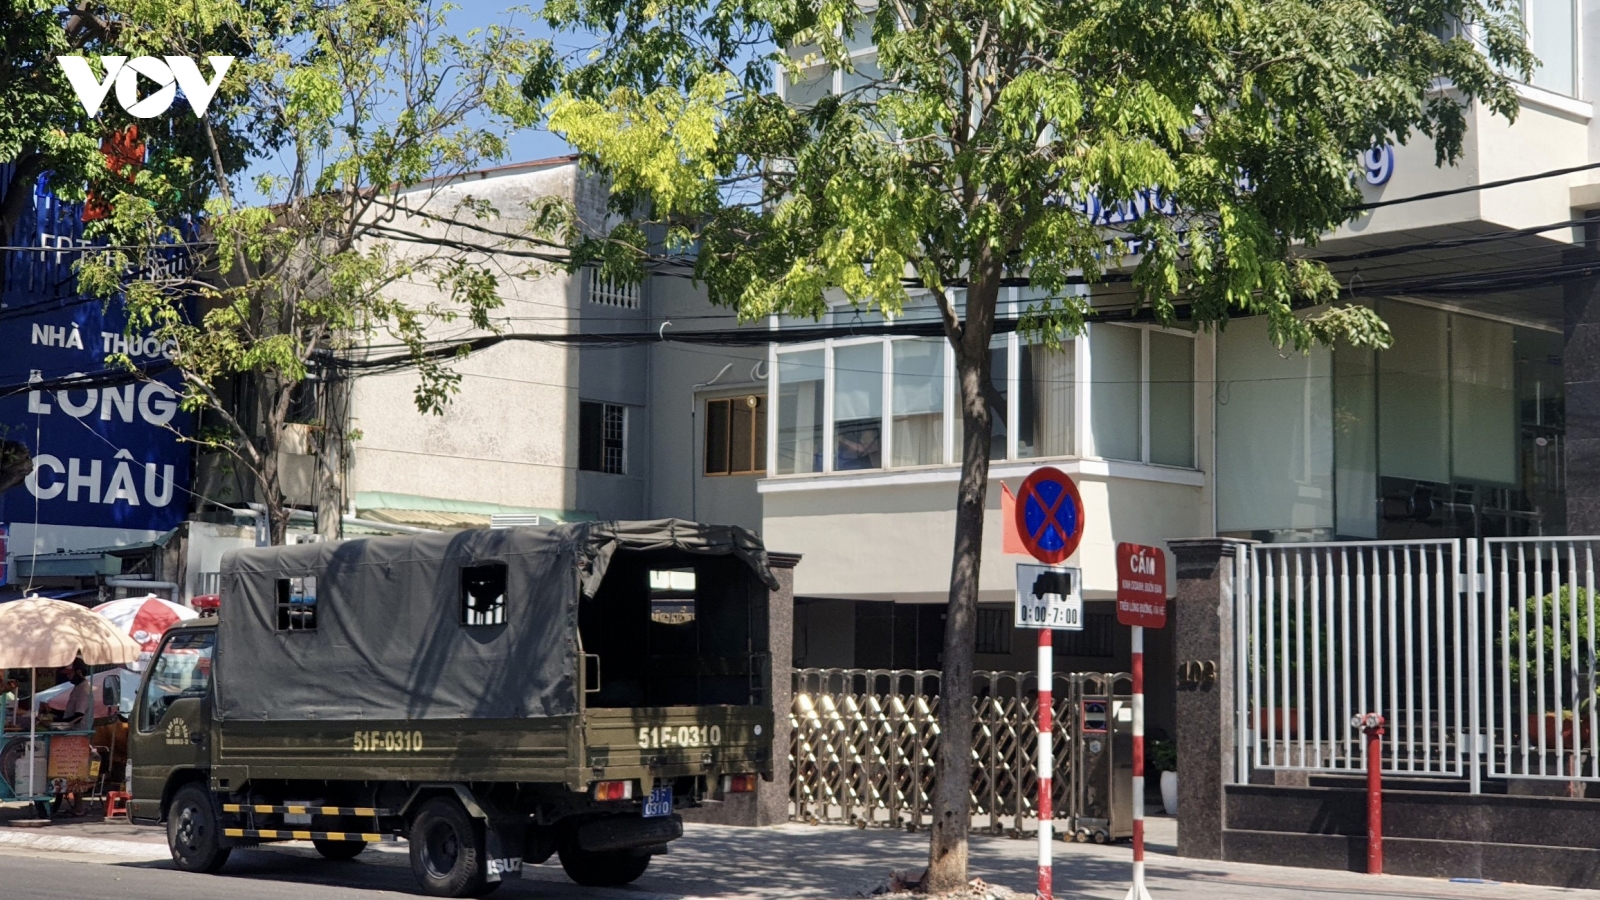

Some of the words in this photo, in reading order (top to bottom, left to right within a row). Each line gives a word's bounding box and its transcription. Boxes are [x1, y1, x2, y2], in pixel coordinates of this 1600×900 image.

[41, 233, 92, 265] FPT
[31, 321, 84, 350] NHÀ
[28, 369, 177, 425] LONG
[24, 448, 174, 507] CHÂU
[1130, 549, 1156, 576] CẤM
[353, 730, 423, 752] 51F-0310
[639, 725, 721, 748] 51F-0310
